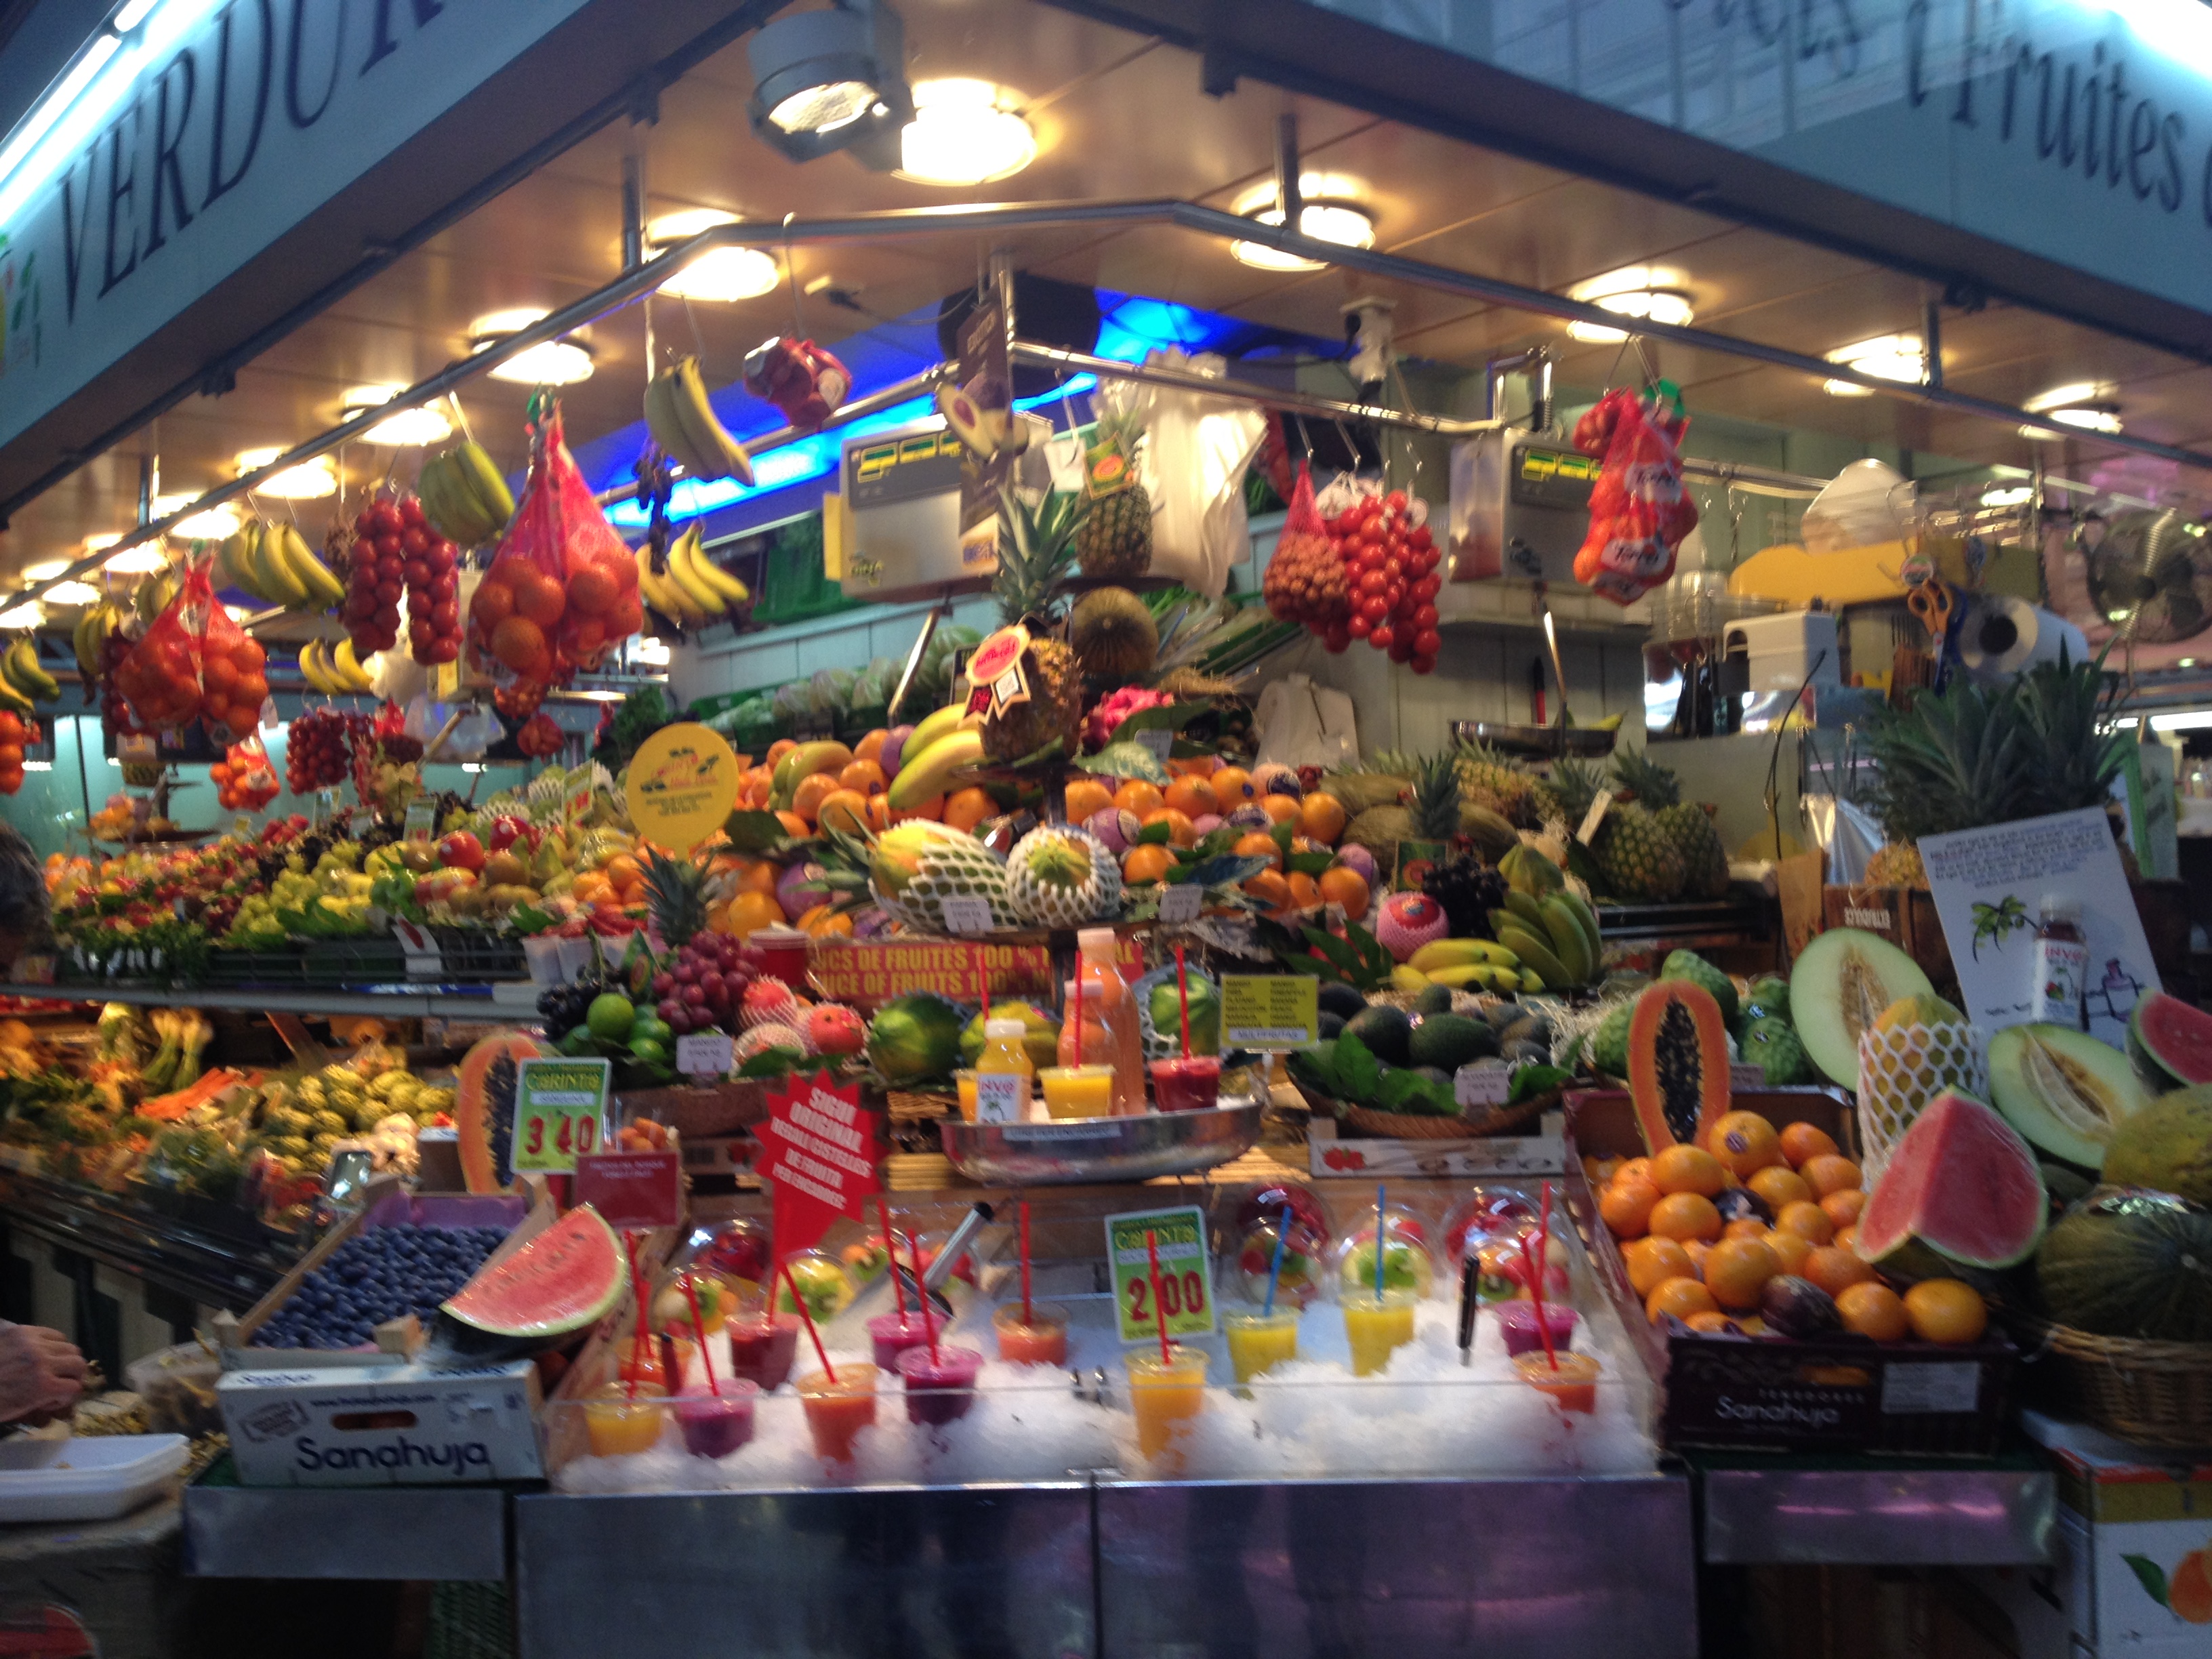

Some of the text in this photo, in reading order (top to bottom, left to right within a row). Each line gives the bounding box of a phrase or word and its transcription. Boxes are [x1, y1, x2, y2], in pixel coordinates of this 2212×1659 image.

[857, 947, 880, 972] DE
[884, 946, 968, 971] FRUITES
[863, 973, 886, 995] OF
[890, 971, 964, 995] FRUITS
[295, 1434, 493, 1477] Sanahuja
